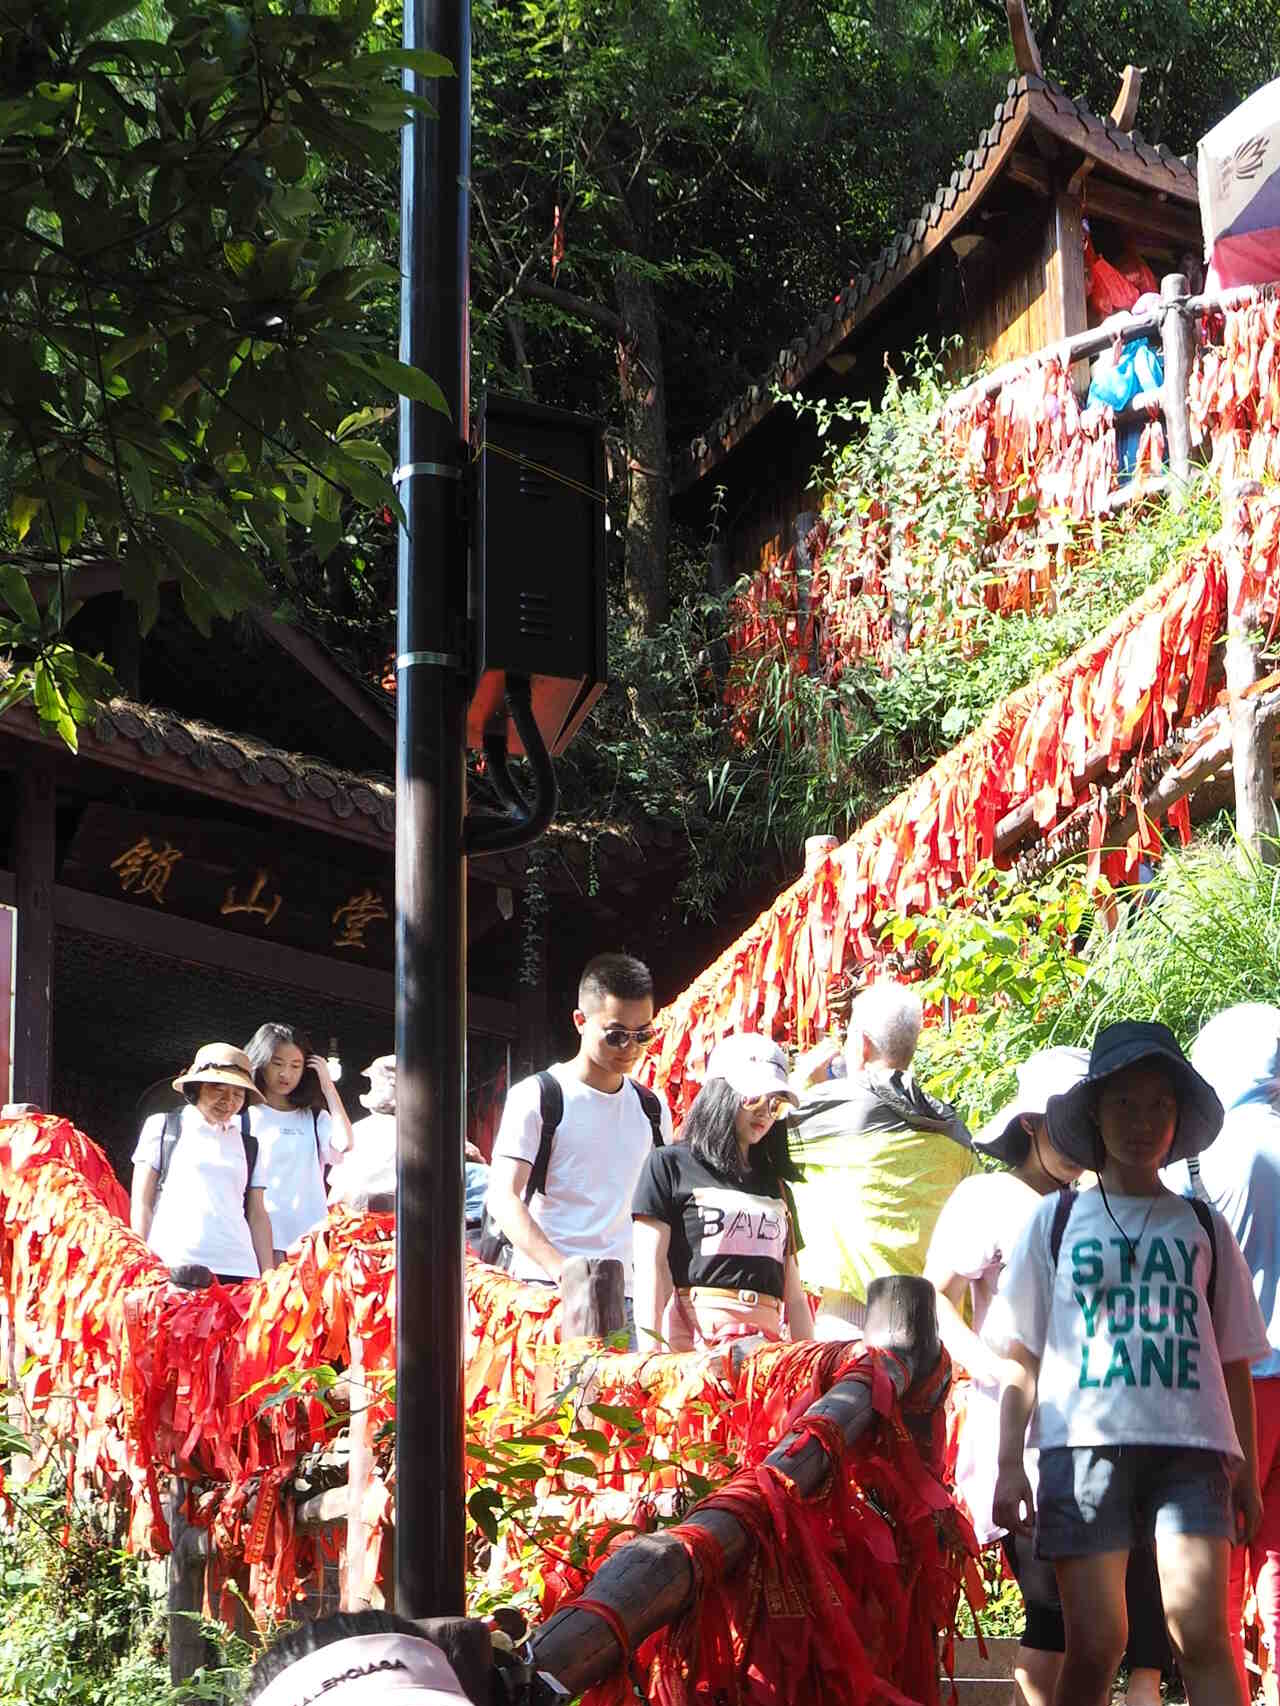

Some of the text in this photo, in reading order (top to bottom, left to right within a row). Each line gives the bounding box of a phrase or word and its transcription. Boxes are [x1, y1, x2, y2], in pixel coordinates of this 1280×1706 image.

[1071, 1237, 1198, 1286] STAY
[1073, 1284, 1199, 1337] YOUR
[1078, 1337, 1201, 1389] LANE
